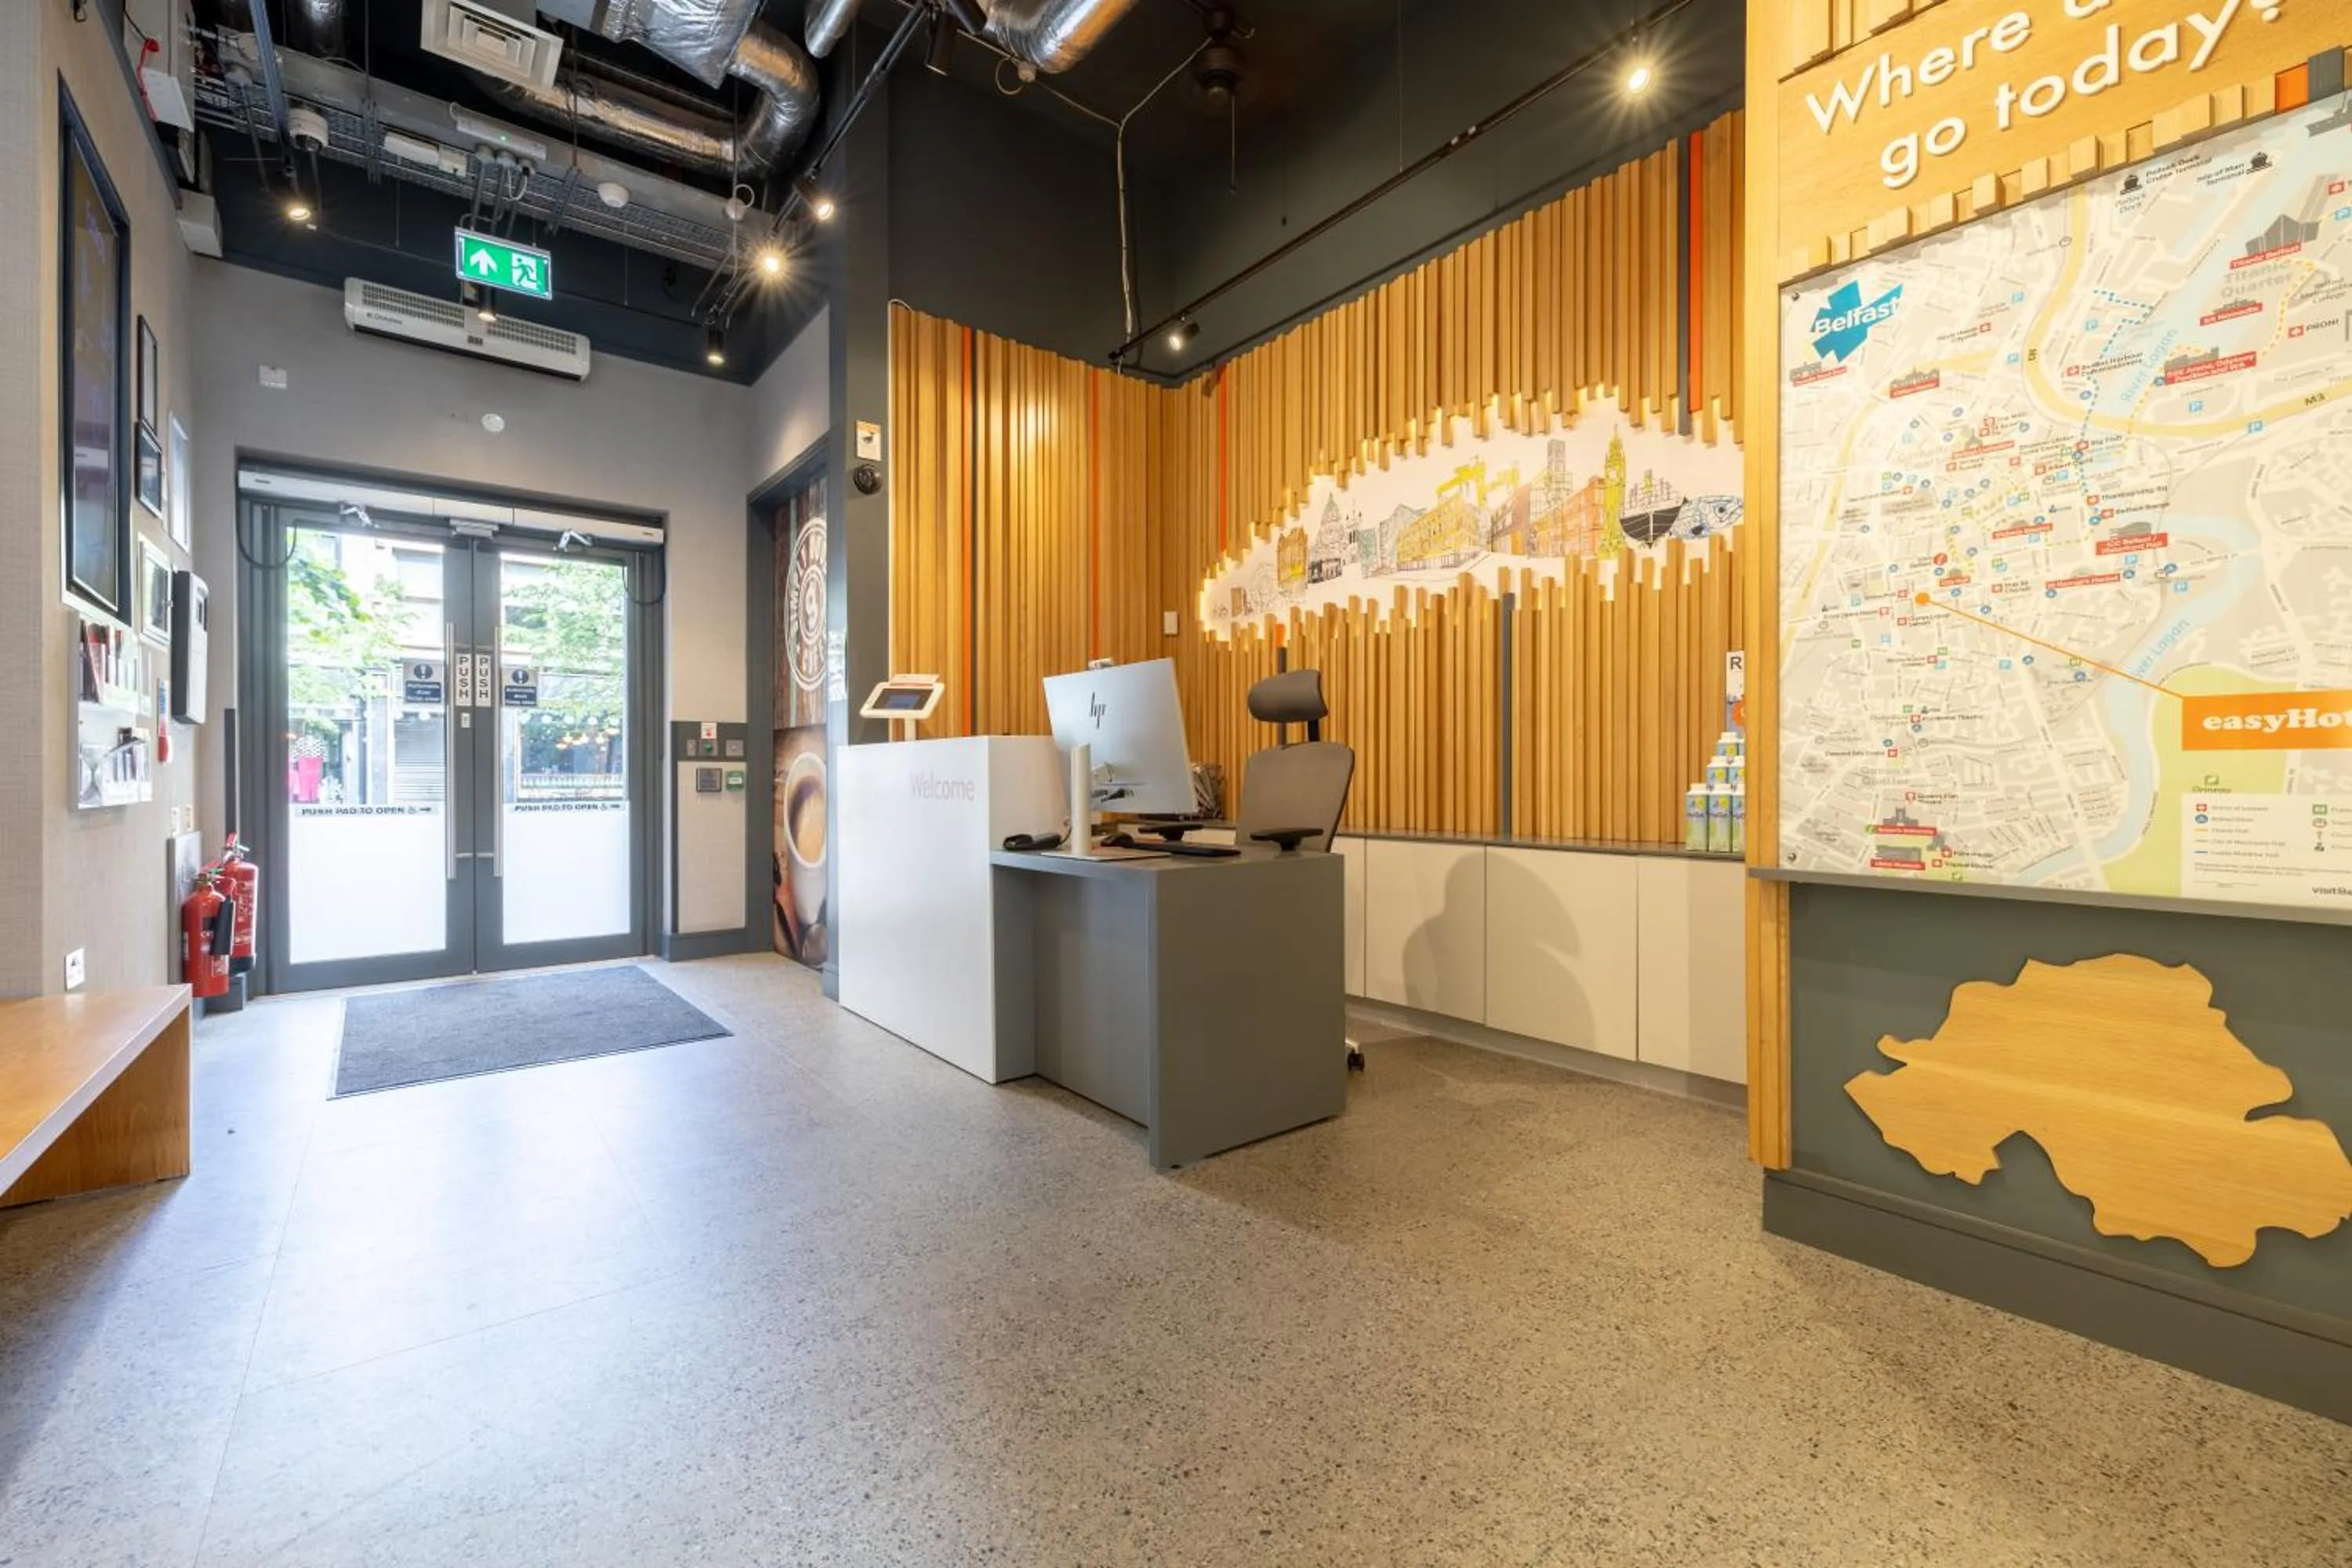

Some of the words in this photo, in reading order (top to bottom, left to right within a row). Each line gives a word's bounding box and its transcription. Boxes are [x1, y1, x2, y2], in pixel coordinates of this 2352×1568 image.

[1805, 8, 2033, 135] Where
[1880, 115, 1966, 189] go
[1814, 296, 1900, 335] Belfast
[459, 656, 469, 699] PUSH
[479, 657, 488, 699] PUSH
[1090, 691, 1106, 729] hp
[910, 769, 975, 802] Welcome
